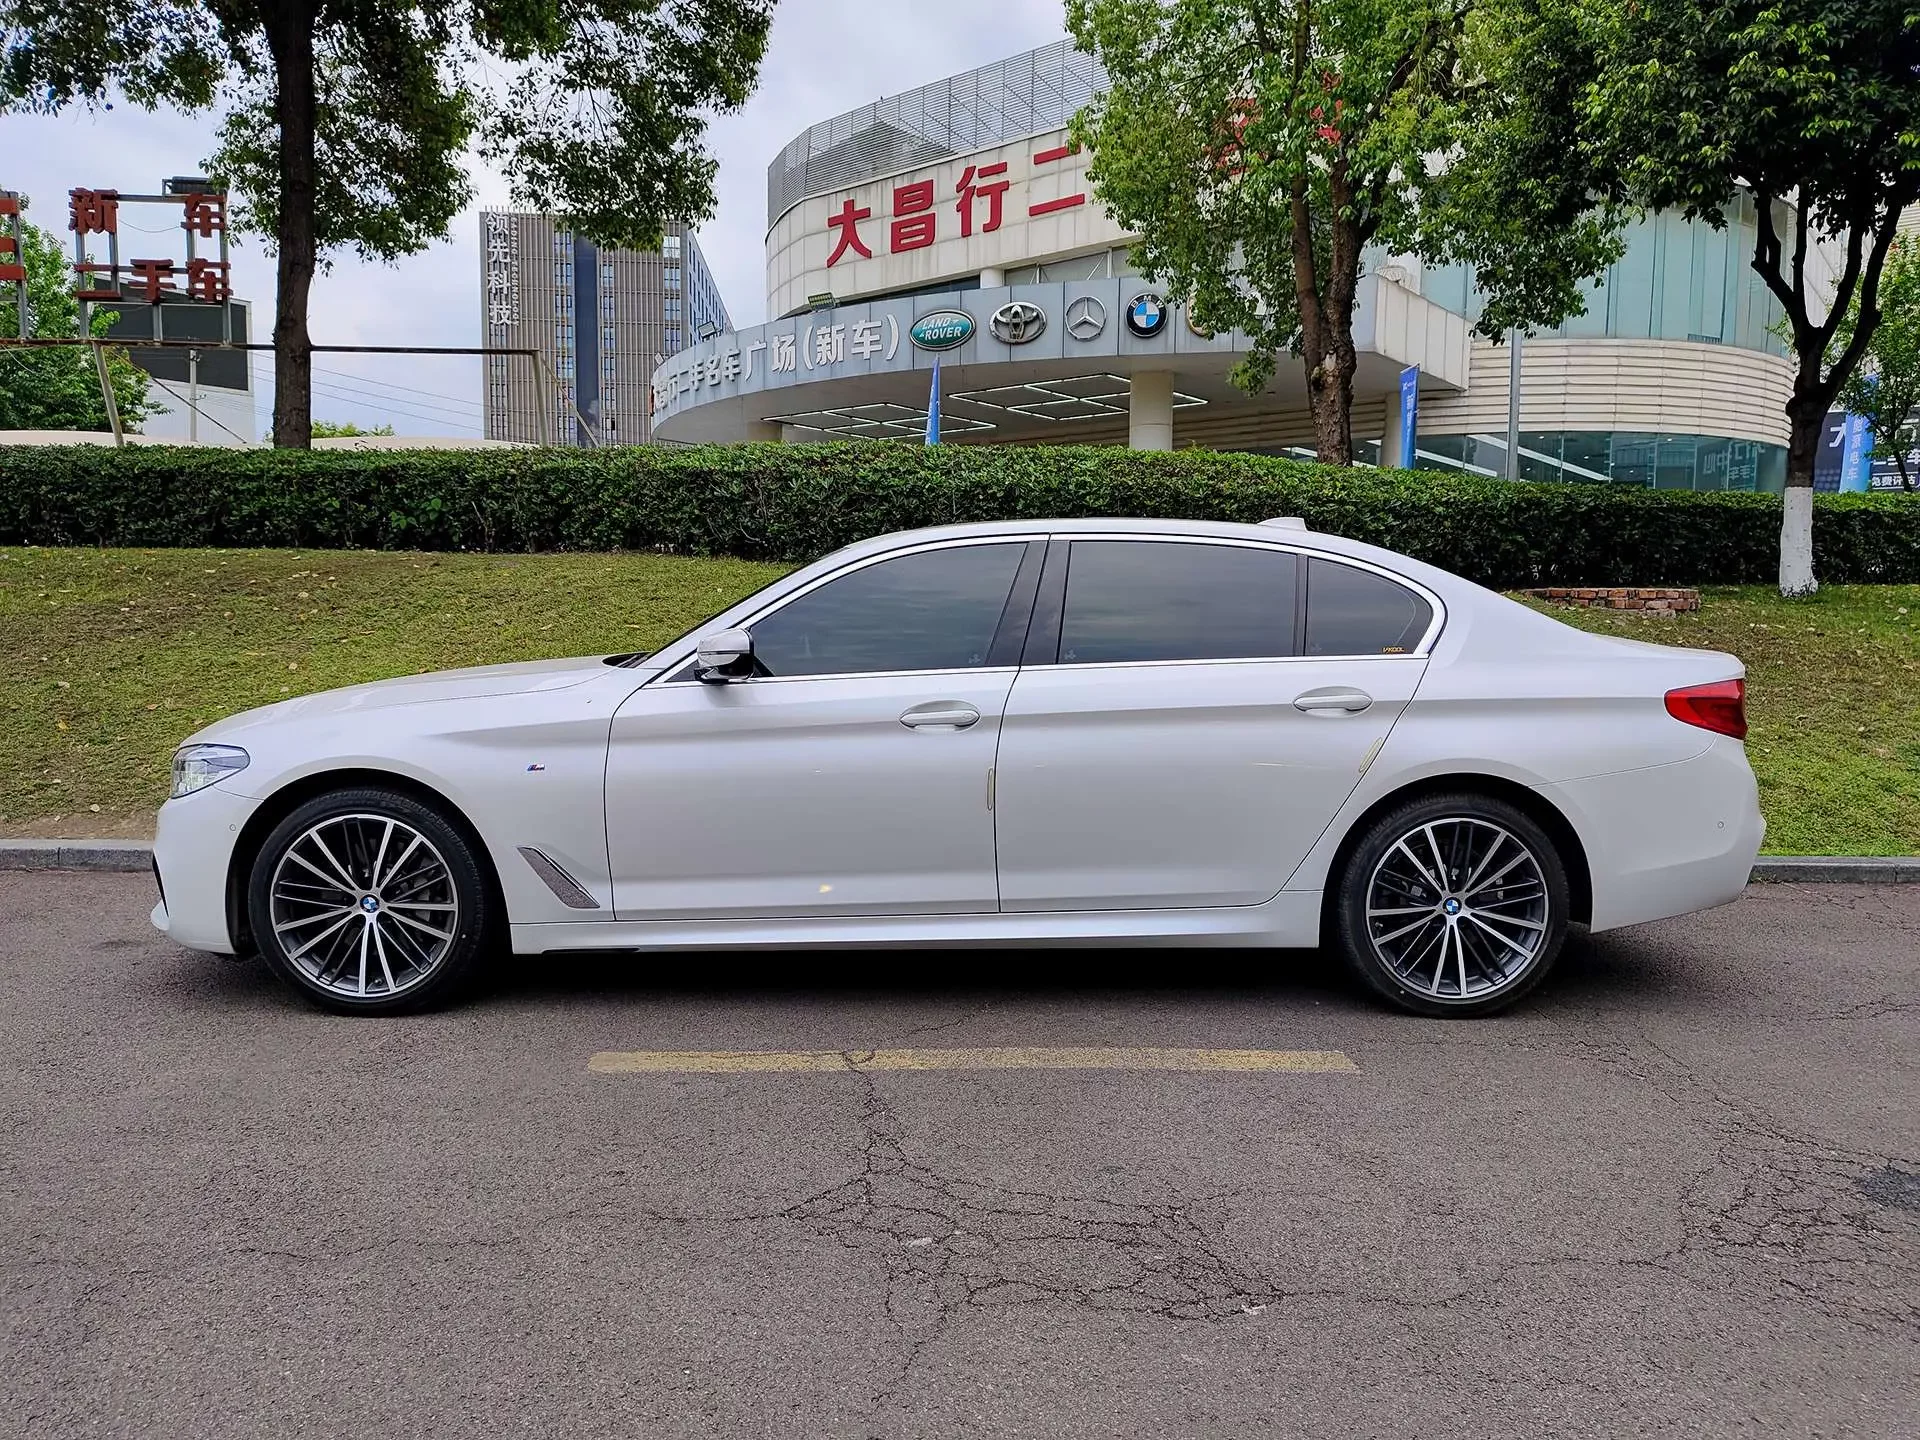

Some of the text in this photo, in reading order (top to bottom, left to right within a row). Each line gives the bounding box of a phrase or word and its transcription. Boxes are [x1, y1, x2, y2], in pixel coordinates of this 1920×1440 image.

[73, 258, 233, 303] 二手车
[486, 212, 511, 325] 领先科技
[922, 317, 951, 330] LAND
[925, 326, 962, 340] ROVER
